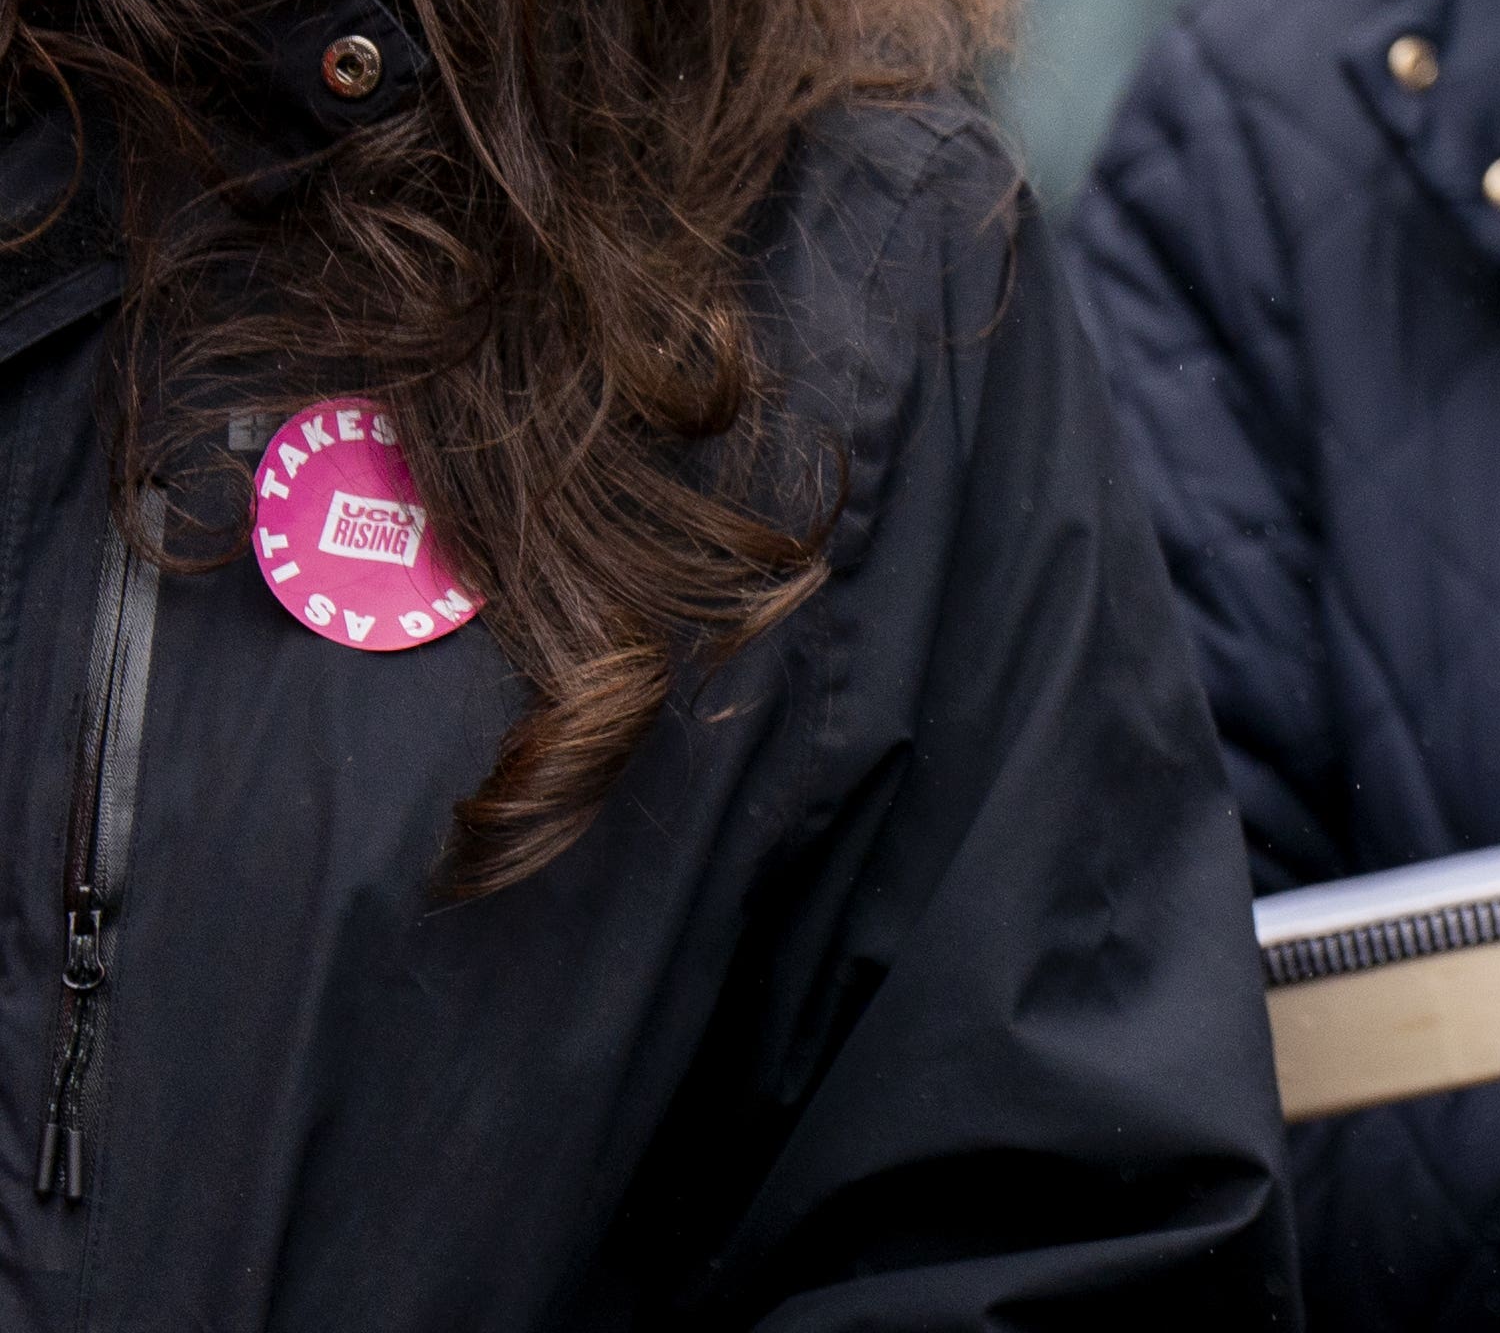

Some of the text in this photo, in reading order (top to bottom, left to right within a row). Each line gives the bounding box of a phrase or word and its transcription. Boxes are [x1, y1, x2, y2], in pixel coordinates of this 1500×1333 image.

[260, 409, 398, 500] TAKES
[259, 526, 301, 584] IT
[331, 516, 410, 559] RISING
[304, 592, 376, 643] AS
